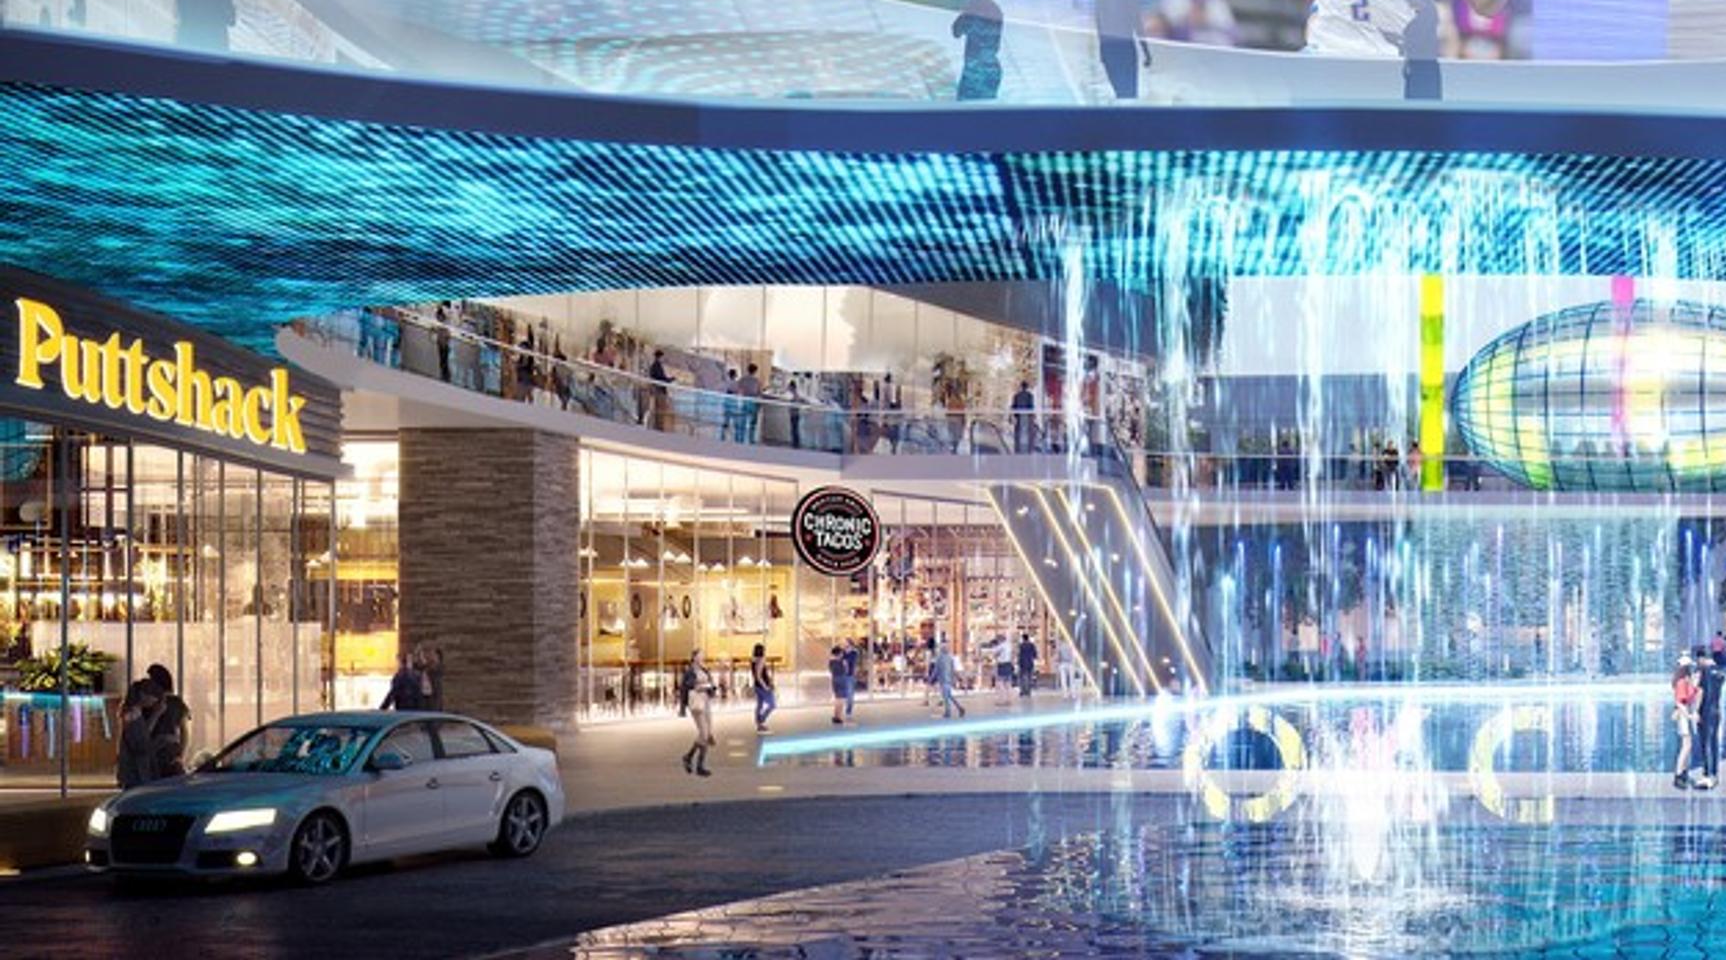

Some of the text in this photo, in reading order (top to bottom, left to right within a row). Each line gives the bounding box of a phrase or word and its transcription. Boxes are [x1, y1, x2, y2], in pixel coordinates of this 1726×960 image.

[14, 296, 309, 455] Puttshack
[803, 512, 872, 536] CHRONIC
[815, 530, 864, 550] TACOS
